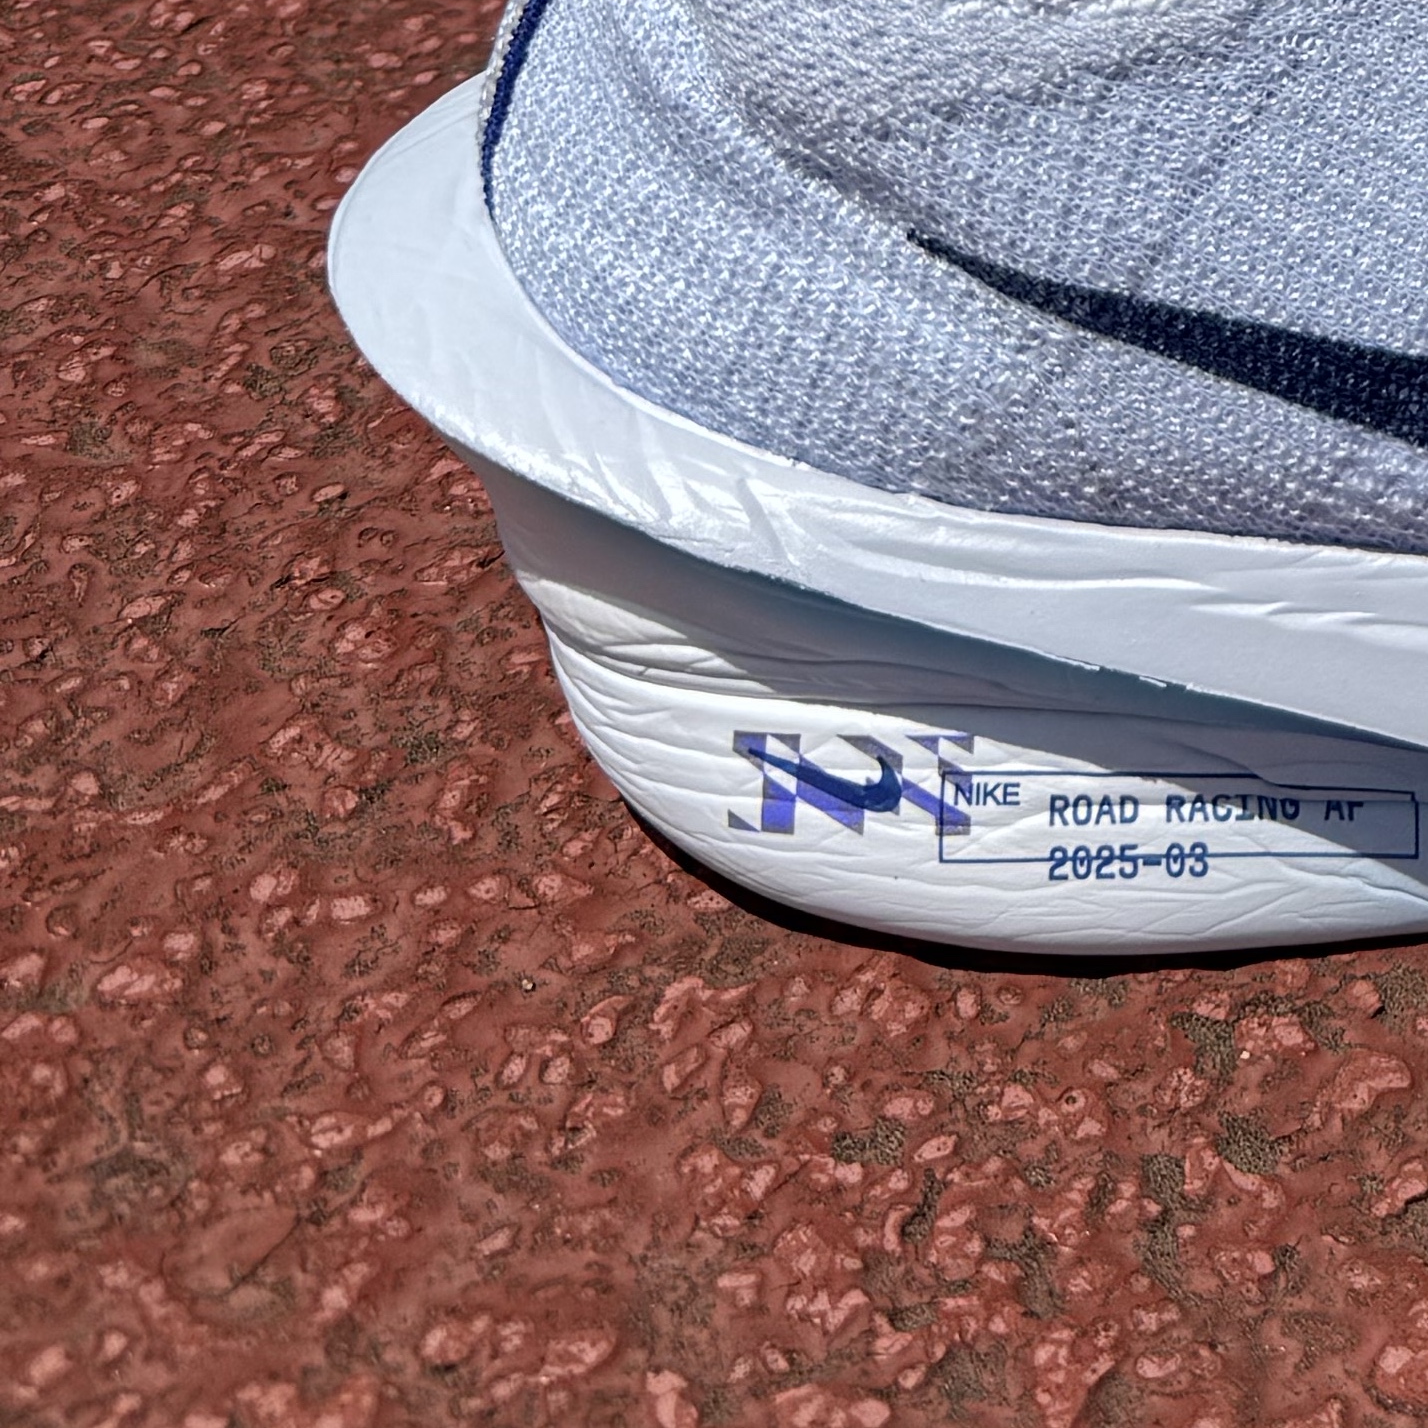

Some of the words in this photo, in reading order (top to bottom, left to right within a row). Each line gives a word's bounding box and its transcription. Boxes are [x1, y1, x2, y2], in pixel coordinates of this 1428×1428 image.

[953, 781, 1021, 807] NIKE
[1049, 793, 1140, 827] ROAD
[1165, 793, 1301, 823] RACING
[1049, 842, 1210, 881] 2025-03
